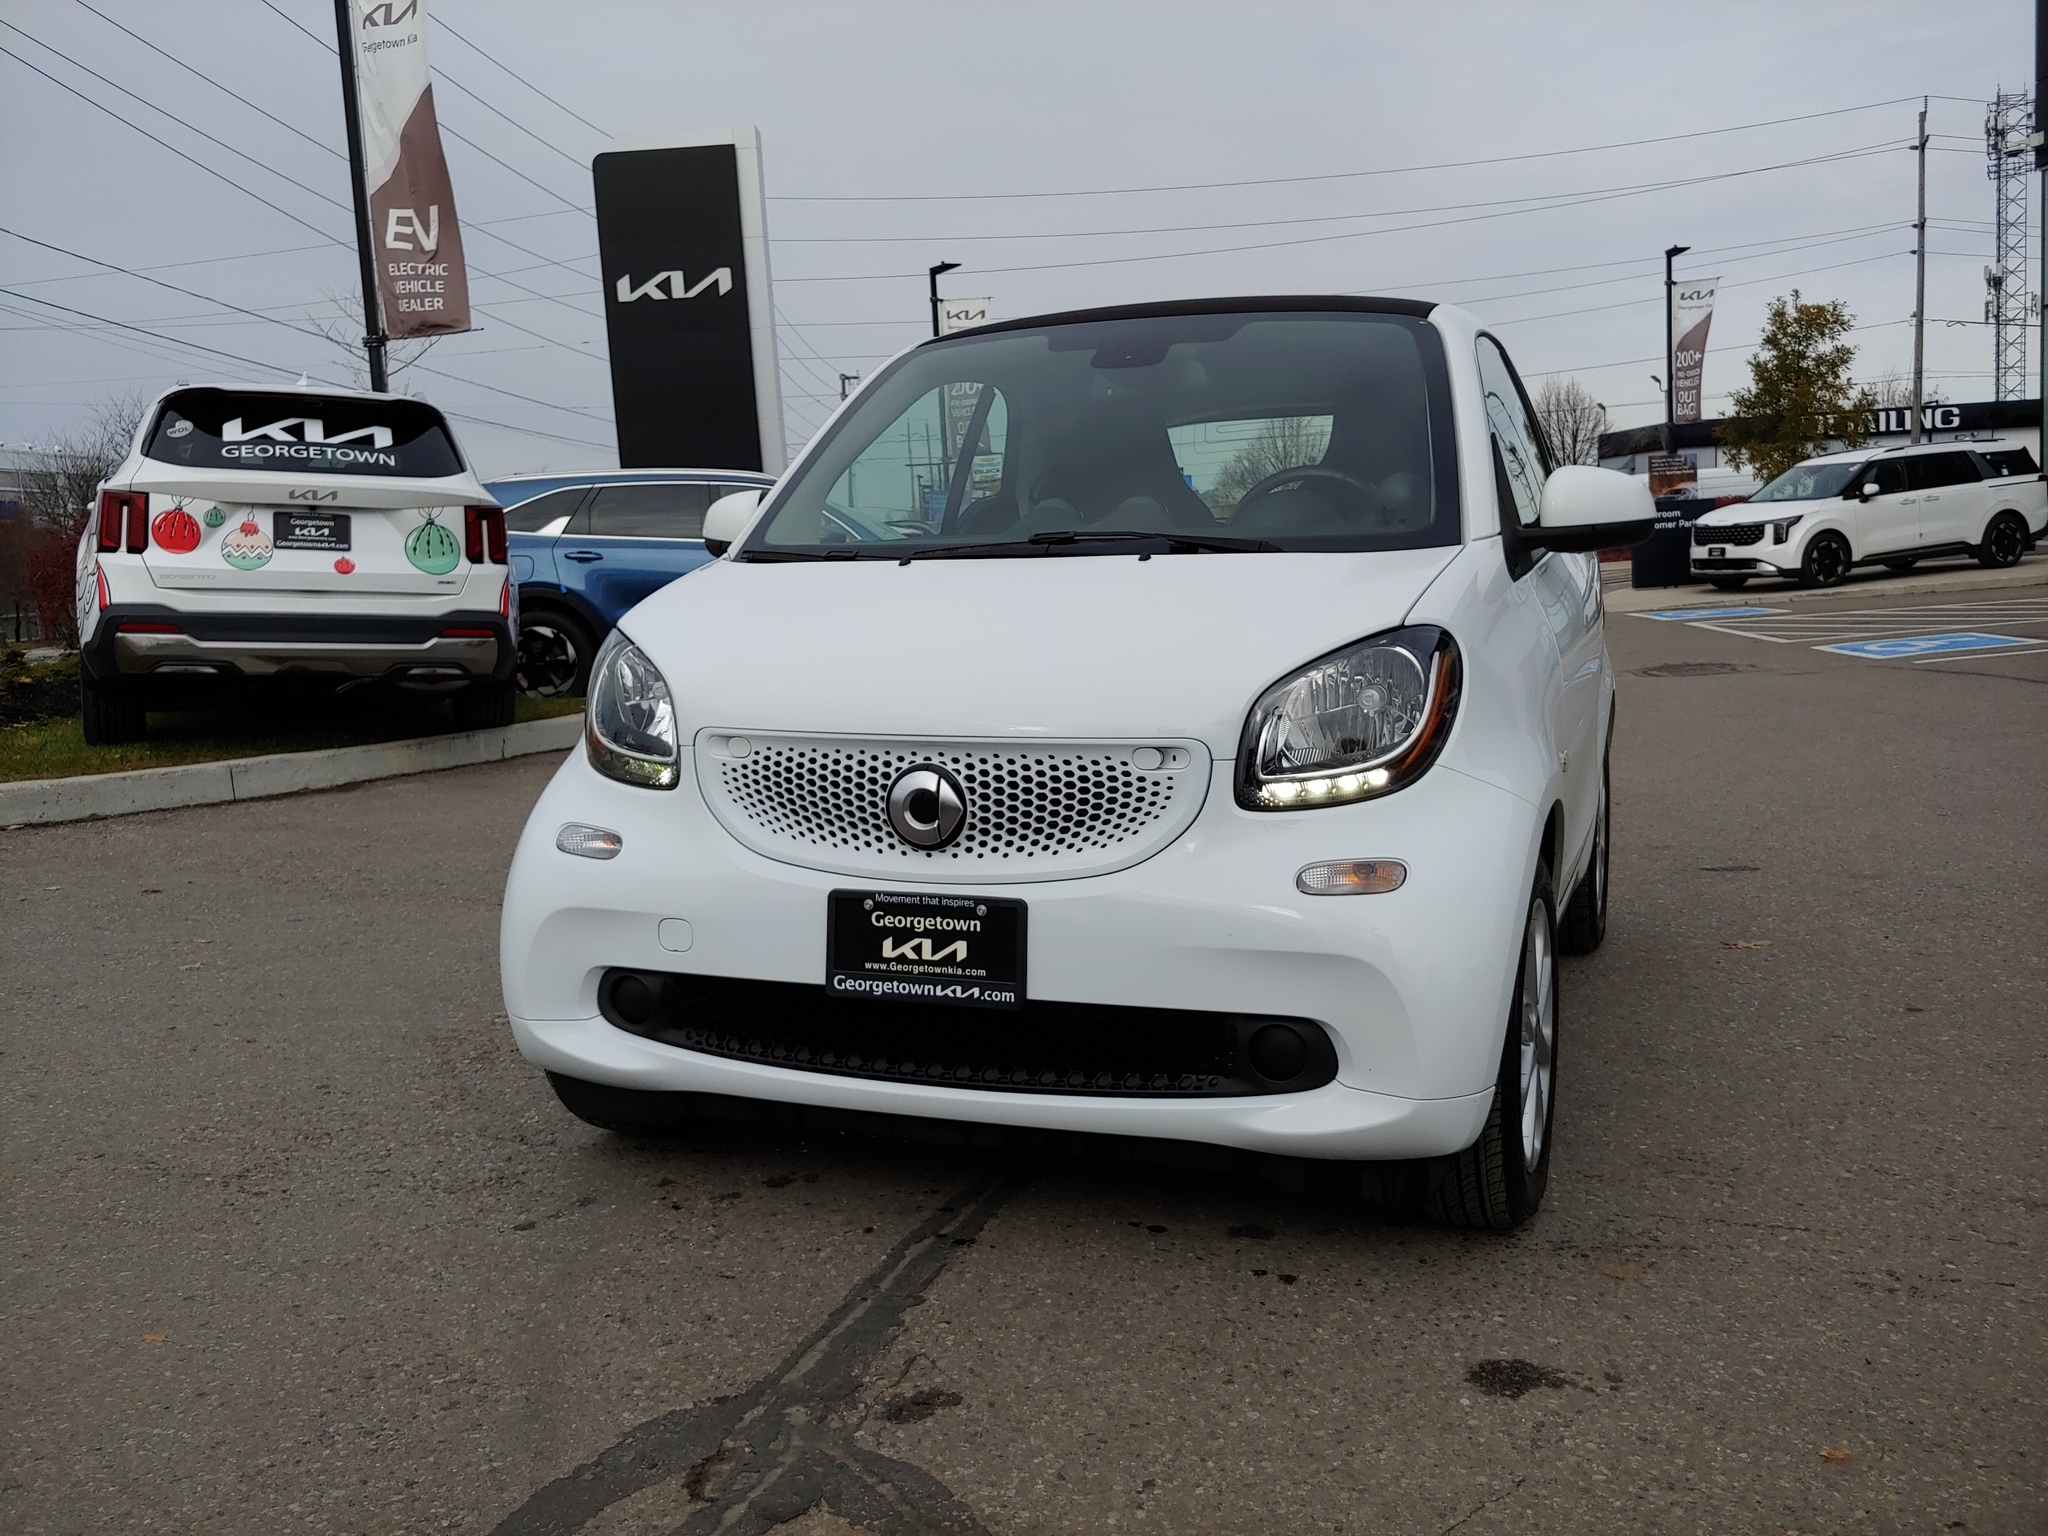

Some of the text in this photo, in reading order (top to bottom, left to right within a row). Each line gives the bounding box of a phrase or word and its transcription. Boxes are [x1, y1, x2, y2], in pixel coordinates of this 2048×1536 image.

[362, 0, 418, 30] KIA
[385, 204, 439, 252] EV
[388, 262, 449, 276] ELECTRIC
[393, 279, 446, 294] VEHICLE
[616, 266, 733, 303] KIA
[1679, 288, 1714, 301] KIA
[398, 297, 445, 312] DEALER
[946, 309, 986, 321] KIA
[1676, 349, 1702, 368] 200+
[1678, 389, 1697, 403] OUT
[222, 417, 393, 449] KIA
[221, 444, 396, 467] GEORGETOWN
[288, 488, 338, 501] KIA
[290, 517, 335, 527] Georgetown
[1654, 521, 1677, 529] omer
[294, 526, 330, 537] KIA
[875, 893, 975, 908] Movement that inspires
[871, 911, 981, 932] Georgetown
[882, 936, 967, 963] KIA
[864, 961, 986, 977] www.Georgetownkia.com
